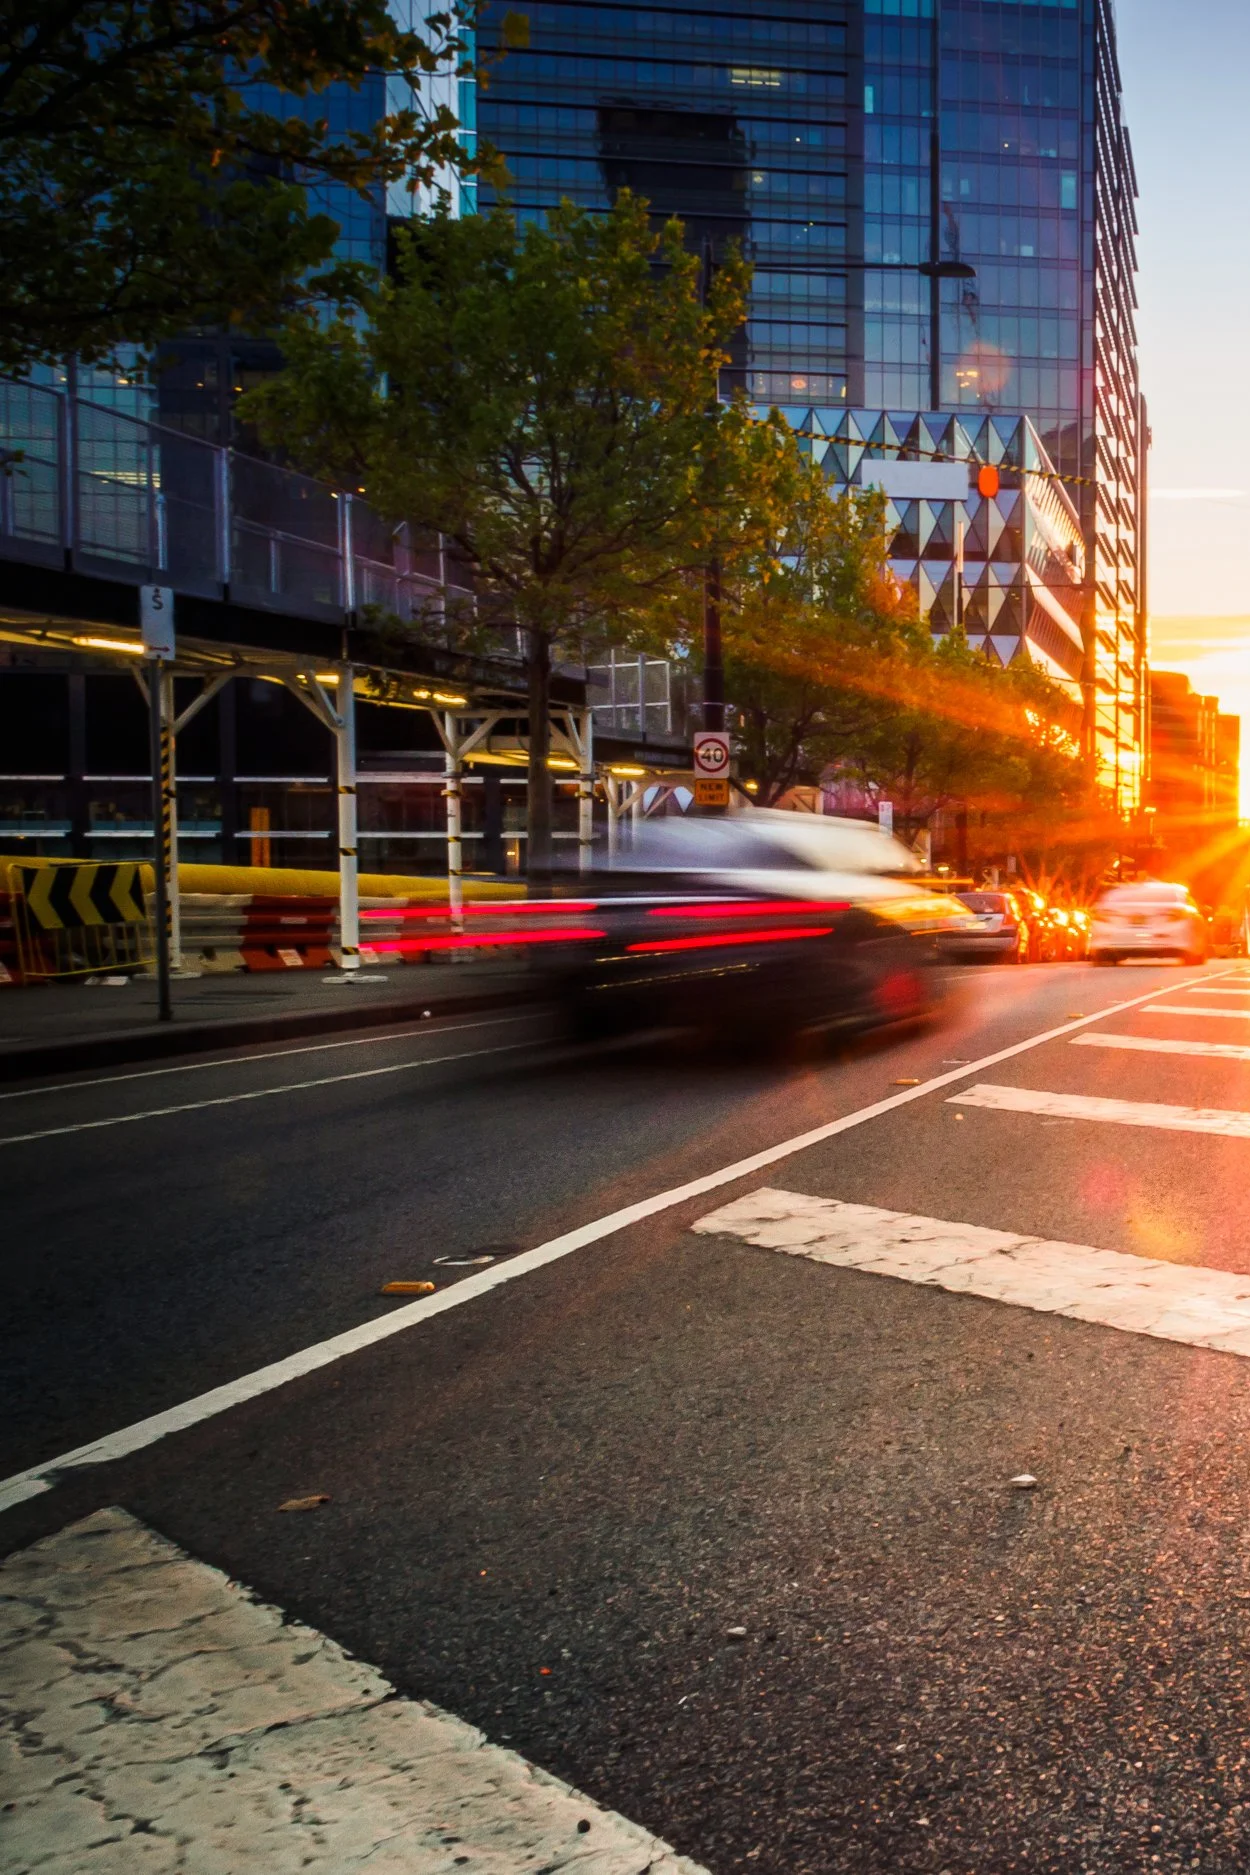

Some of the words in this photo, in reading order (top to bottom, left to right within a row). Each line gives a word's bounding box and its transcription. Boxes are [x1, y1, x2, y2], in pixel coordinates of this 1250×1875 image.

[701, 748, 723, 763] 40
[700, 783, 723, 791] NEW
[699, 792, 725, 801] LIMIT
